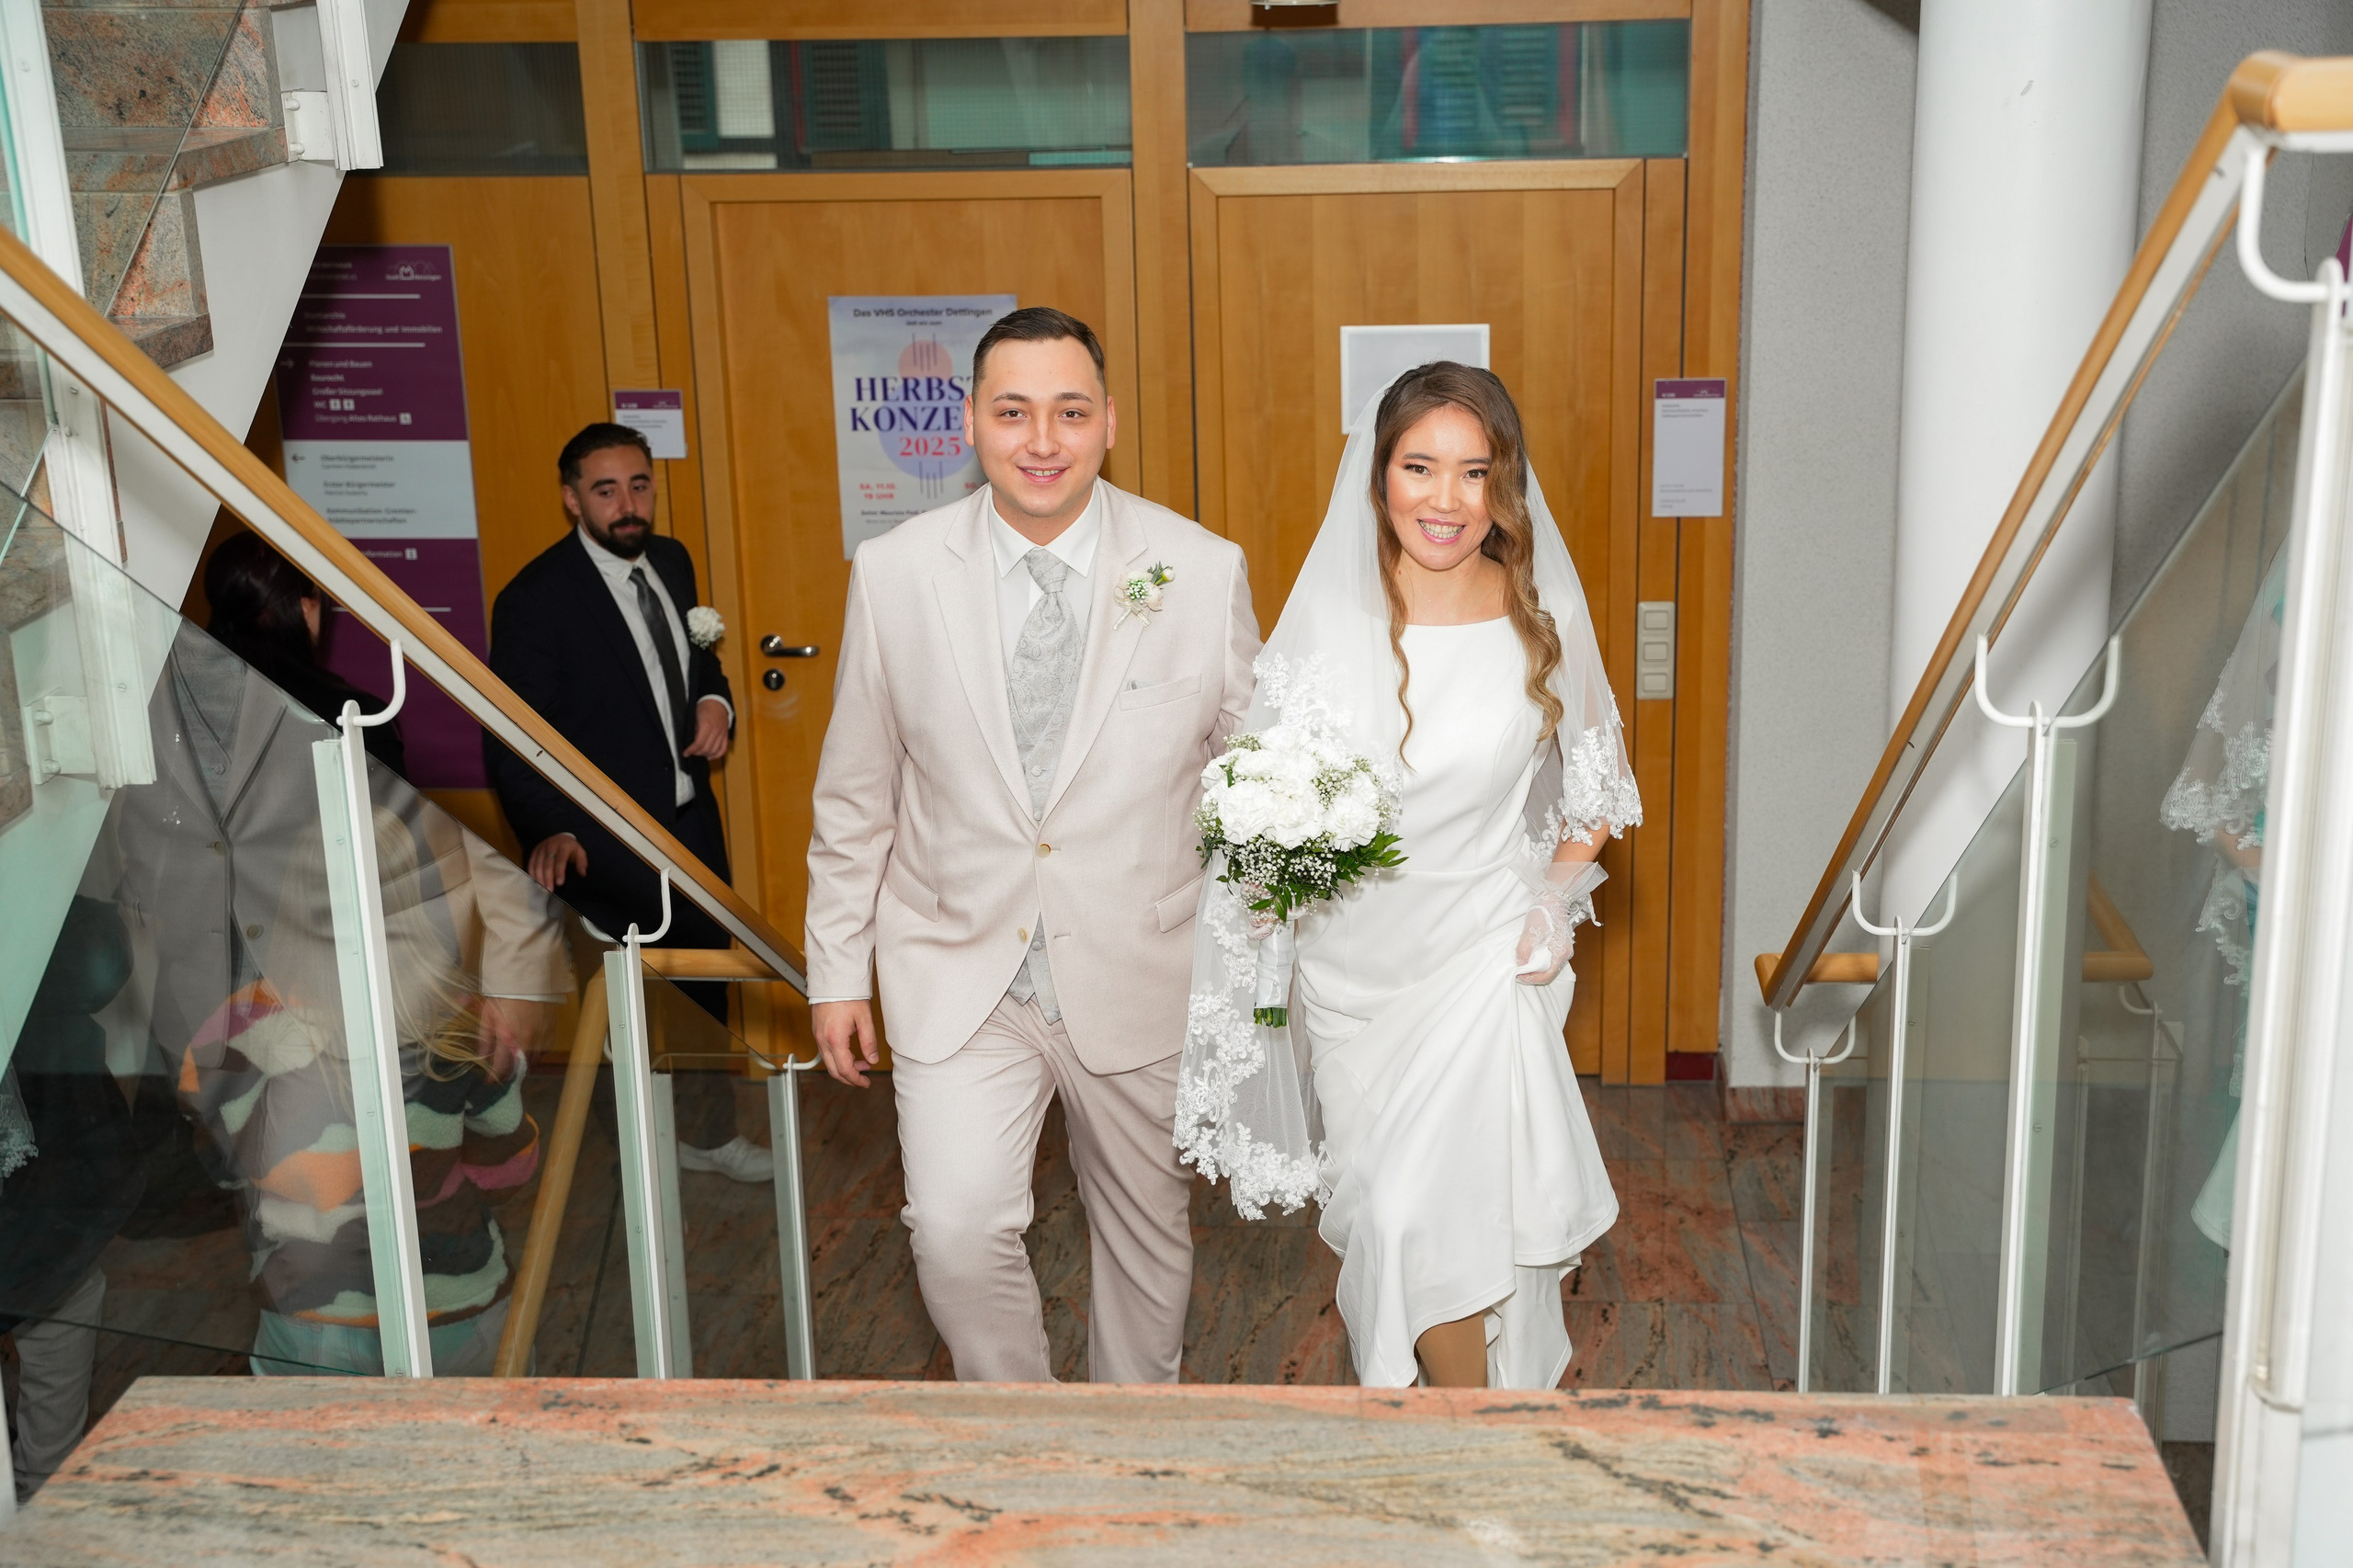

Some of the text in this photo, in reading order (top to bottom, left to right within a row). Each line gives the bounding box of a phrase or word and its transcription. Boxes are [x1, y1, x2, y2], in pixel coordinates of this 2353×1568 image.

[853, 307, 994, 319] Das VHS Orchester Dettingen
[384, 324, 399, 334] und
[401, 324, 443, 334] Immobilien
[855, 376, 972, 403] HERBS
[850, 405, 962, 432] KONZE
[900, 436, 961, 457] 2025
